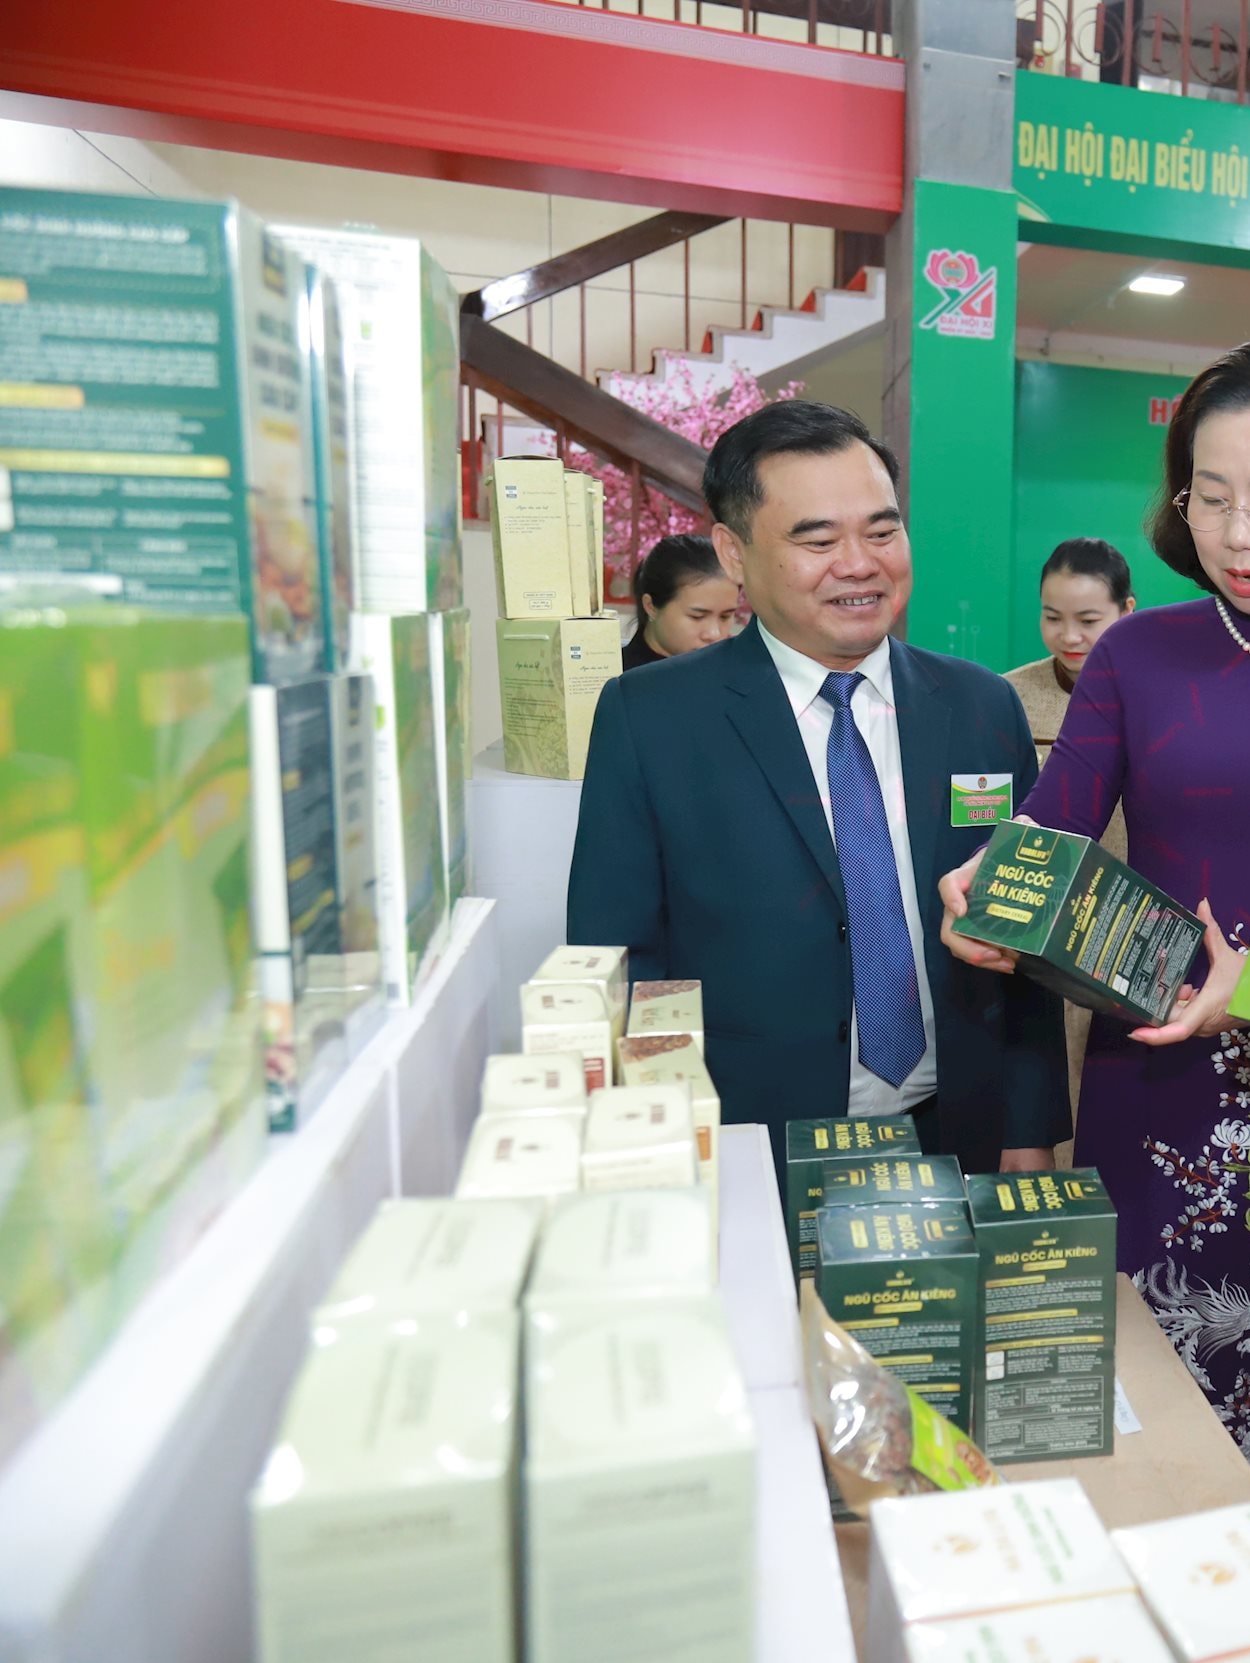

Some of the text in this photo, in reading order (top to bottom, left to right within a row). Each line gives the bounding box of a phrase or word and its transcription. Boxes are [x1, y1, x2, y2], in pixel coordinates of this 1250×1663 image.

[1019, 121, 1058, 180] ĐẠI
[1065, 121, 1104, 187] HỘI
[1110, 135, 1149, 193] ĐẠI
[1155, 128, 1206, 193] BIỂU
[1212, 144, 1248, 208] HỘI
[995, 864, 1054, 888] NGŨ CỐC
[1088, 867, 1104, 895] KIÊNG
[987, 880, 1046, 907] ĂN KIÊNG
[1043, 1191, 1065, 1210] CỐC
[995, 1246, 1098, 1265] NGŨ CỐC ĂN KIÊNG
[844, 1287, 956, 1305] NGŨ CỐC ĂN KIÊNG
